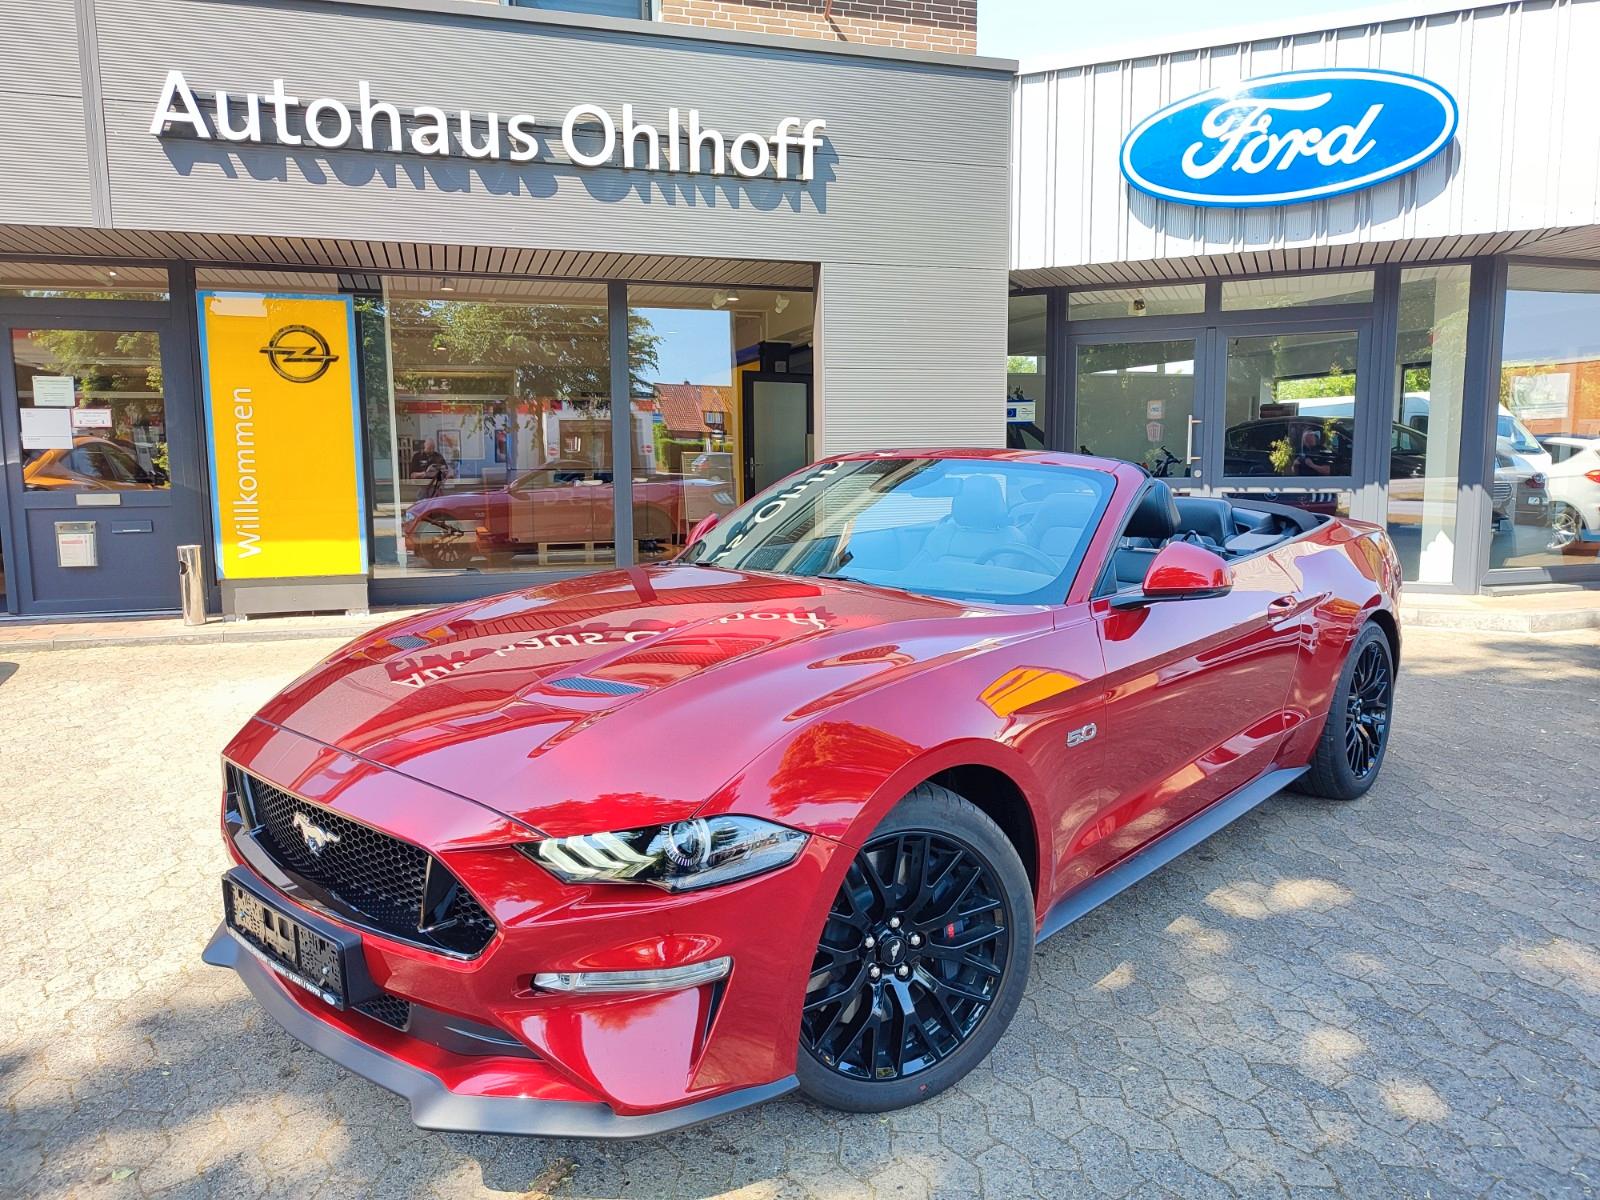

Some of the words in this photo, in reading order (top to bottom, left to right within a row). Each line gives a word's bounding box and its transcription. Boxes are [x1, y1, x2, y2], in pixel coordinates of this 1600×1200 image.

[150, 69, 539, 162] Autohaus
[560, 102, 827, 182] Ohlhoff
[1181, 92, 1385, 180] Ford
[232, 387, 263, 560] Willkommen
